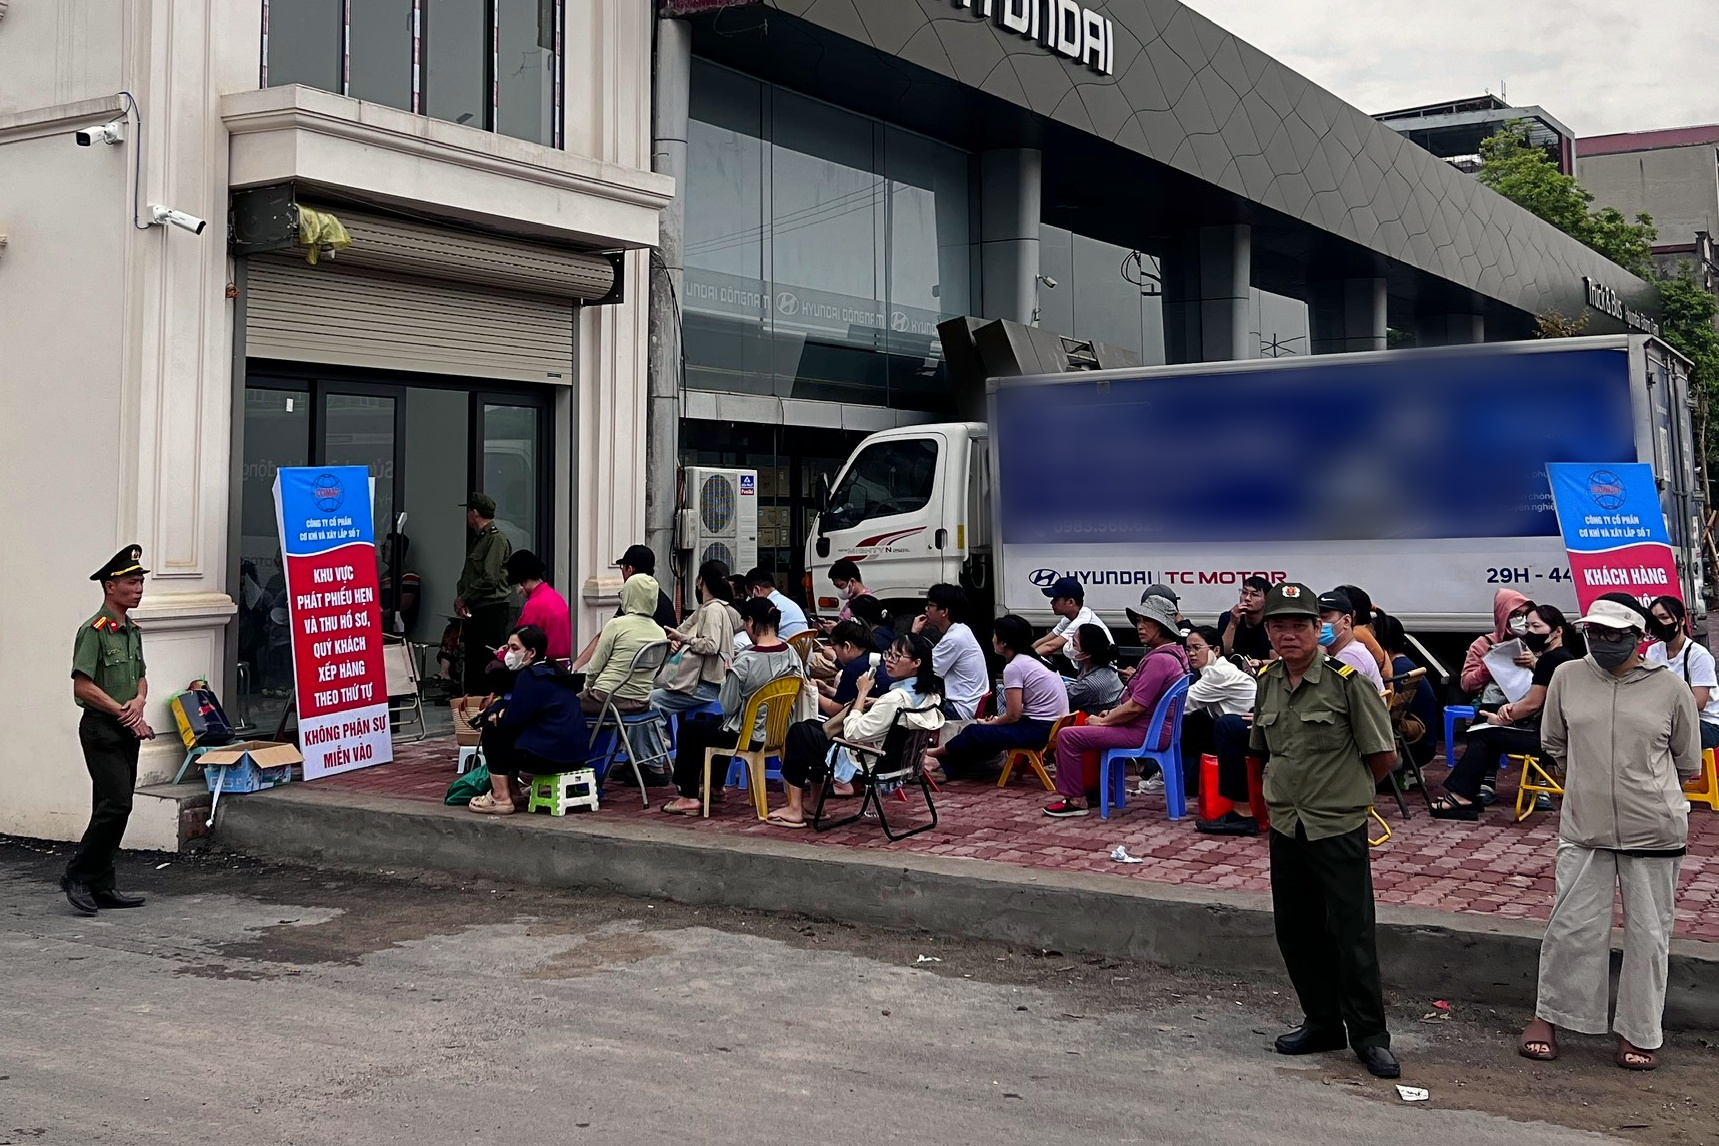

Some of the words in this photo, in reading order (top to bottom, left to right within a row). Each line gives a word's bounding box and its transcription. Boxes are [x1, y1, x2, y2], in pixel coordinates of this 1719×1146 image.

[961, 0, 1114, 76] UNDAI
[684, 281, 718, 300] UNDAI
[802, 301, 840, 321] HYUNDAI
[321, 518, 329, 528] TY
[1602, 516, 1611, 525] TY
[356, 529, 361, 538] 7
[1645, 528, 1651, 537] 7
[313, 567, 334, 584] KHU
[335, 564, 354, 584] VỰC
[1066, 570, 1153, 585] HYUNDAI
[1165, 571, 1195, 585] TC
[1198, 571, 1288, 585] MOTOR
[1486, 567, 1530, 584] 29H
[1583, 565, 1630, 586] KHÁCH
[1630, 564, 1668, 585] HÀNG
[296, 590, 323, 610] PHÁT
[324, 585, 353, 608] PHIẾU
[354, 586, 374, 606] HẸN
[303, 615, 318, 635] VÀ
[319, 615, 338, 633] THU
[339, 609, 353, 630] HỒ
[354, 610, 371, 628] SƠ,
[313, 638, 333, 659] QUÝ
[334, 635, 366, 655] KHÁCH
[318, 661, 337, 683] XẾP
[339, 659, 366, 679] HÀNG
[313, 689, 339, 708] THEO
[340, 682, 360, 703] THỨ
[360, 681, 373, 702] TỰ
[304, 724, 341, 747] KHÔNG
[342, 717, 370, 739] PHẬN
[372, 713, 387, 734] SỰ
[323, 744, 351, 769] MIỄN
[352, 742, 373, 762] VÀO
